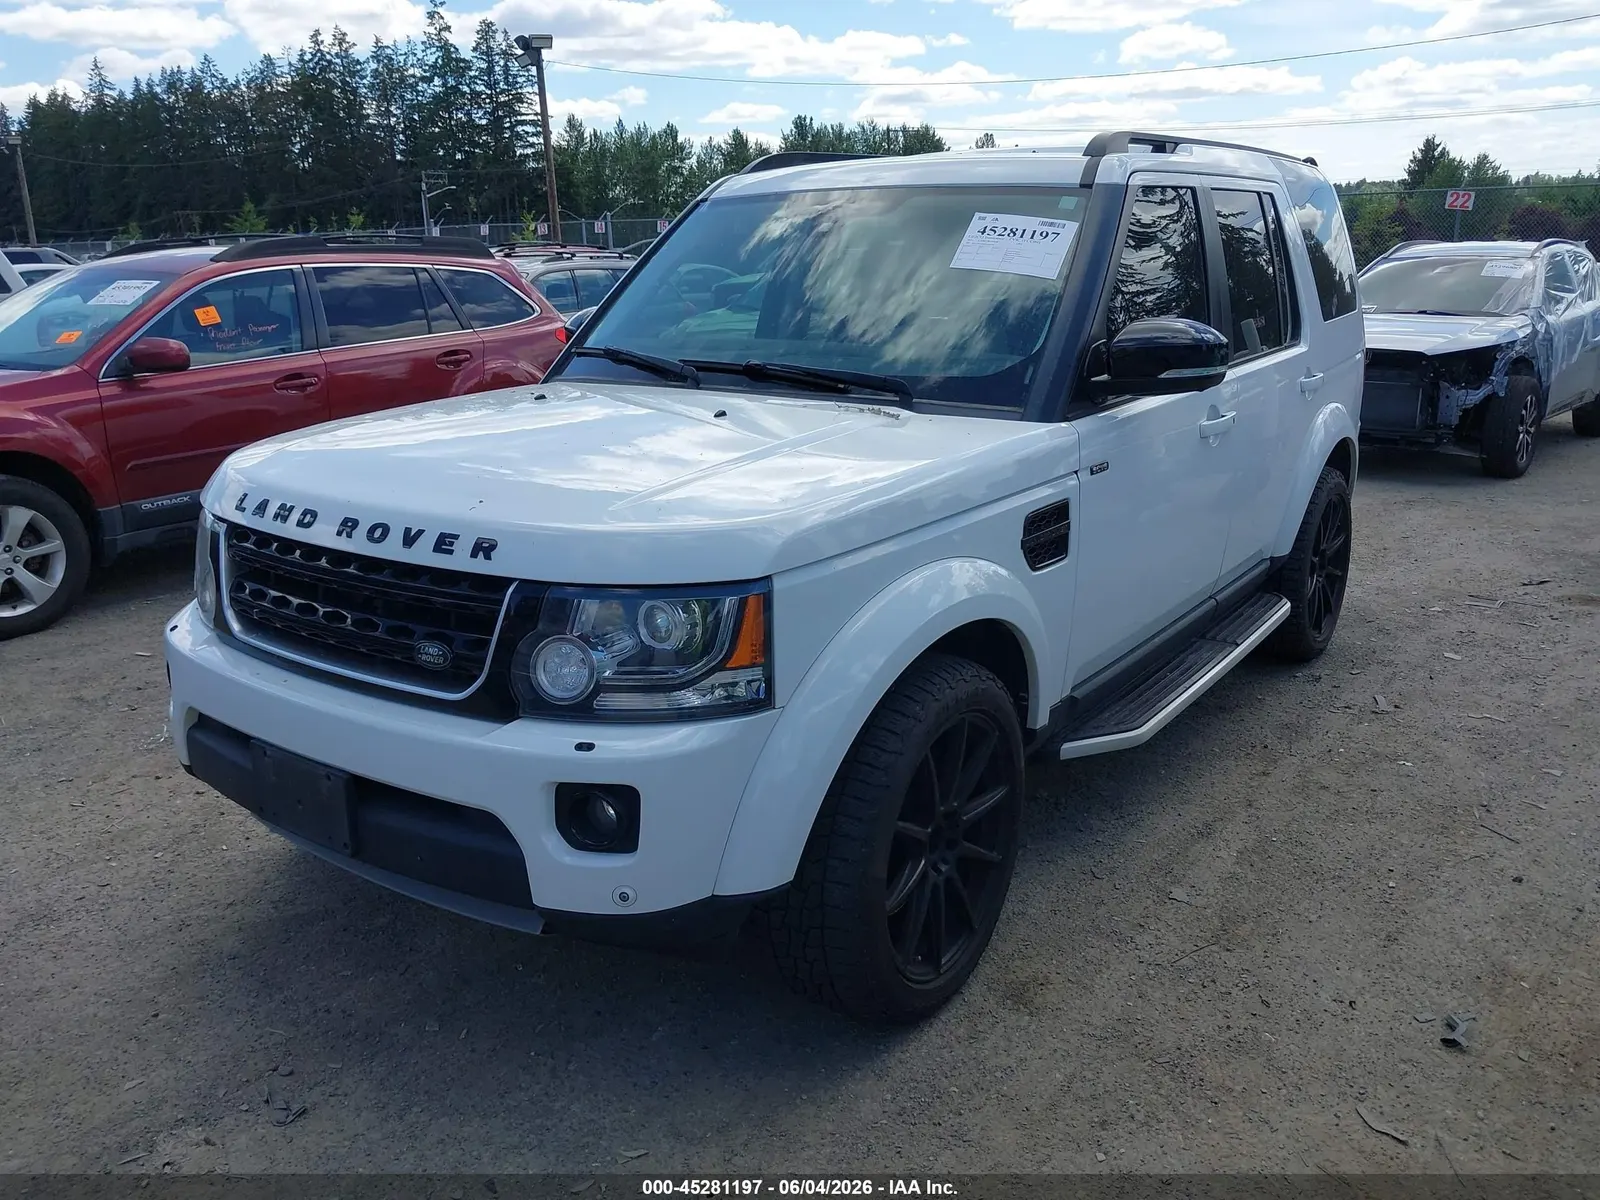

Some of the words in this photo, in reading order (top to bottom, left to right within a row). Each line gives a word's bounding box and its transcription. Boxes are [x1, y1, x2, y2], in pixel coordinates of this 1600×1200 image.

[1447, 191, 1472, 209] 22
[977, 225, 1061, 243] 45281197
[141, 495, 191, 510] OUTBACK
[234, 492, 319, 529] LAND
[336, 516, 499, 561] ROVER
